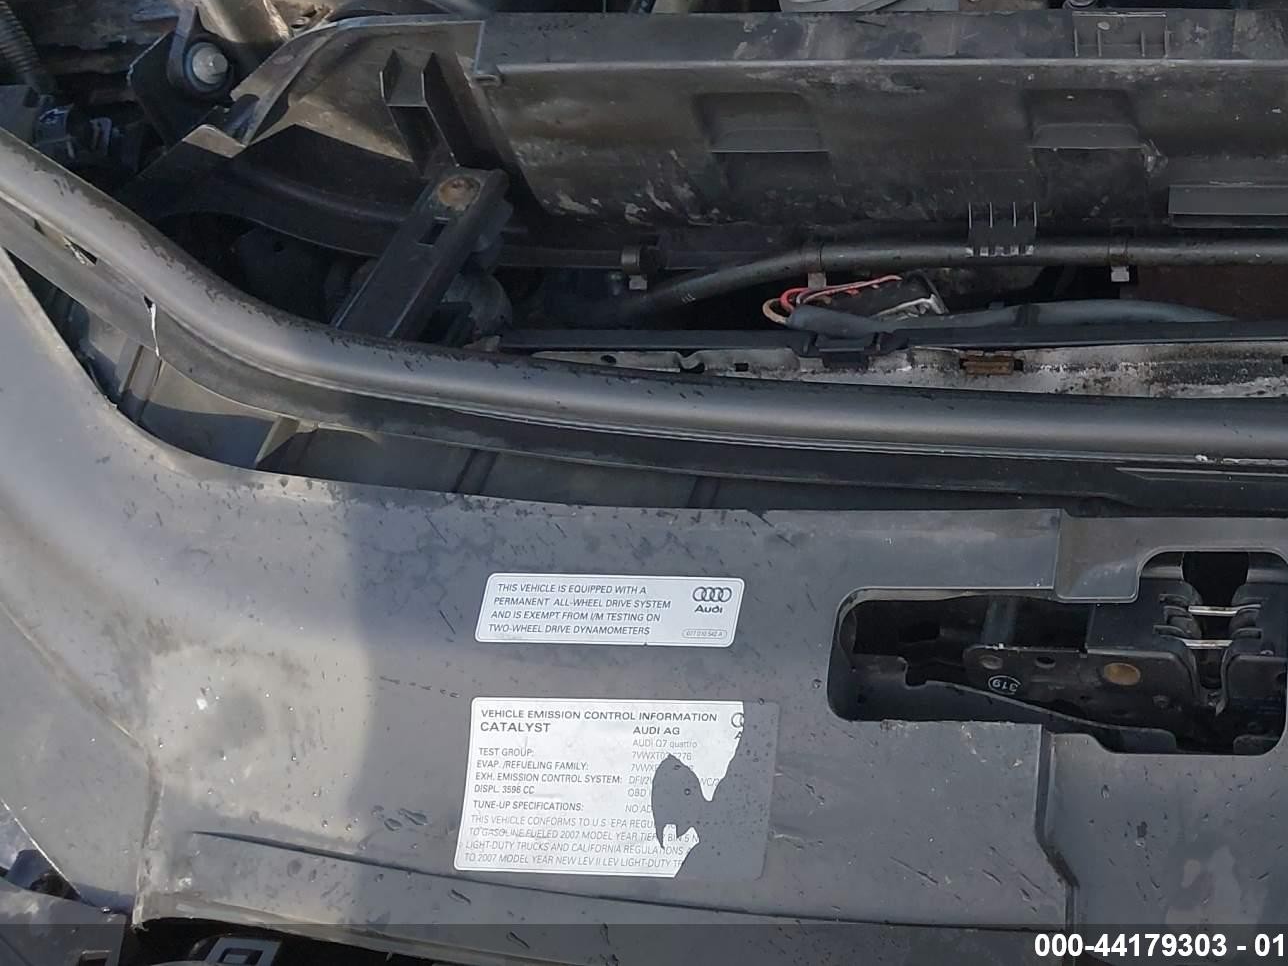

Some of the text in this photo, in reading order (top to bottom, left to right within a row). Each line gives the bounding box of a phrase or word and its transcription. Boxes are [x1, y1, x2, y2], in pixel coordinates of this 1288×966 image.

[498, 583, 647, 594] THIS VEHICLE IS EQUIPPED WITH A
[493, 596, 671, 609] PERMANENT ALL-WHEEL DRIVE SYSTEM
[694, 604, 723, 614] Audi
[491, 610, 661, 622] AND IS EXEMPT FROM I/M TESTING ON
[488, 624, 650, 635] TWO-WHEEL DRIVE DYNAMOMETERS
[481, 709, 718, 722] VEHICLE EMISSION CONTROL INFORMATION
[480, 721, 552, 733] CATALYST
[633, 726, 681, 735] AUDI AG
[632, 738, 654, 747] AUDI
[655, 739, 668, 748] Q7
[479, 747, 534, 757] TEST GROUP:
[502, 761, 553, 770] /REFUELING
[554, 762, 589, 771] FAMILY:
[475, 772, 495, 781] EXH.
[497, 772, 539, 782] EMISSION
[541, 773, 582, 783] CONTROL
[584, 774, 622, 784] SYSTEM:
[523, 786, 535, 794] CC
[627, 788, 647, 797] OBD
[473, 800, 584, 812] TUNE-UP SPECIFICATIONS:
[625, 804, 639, 813] NO
[471, 814, 577, 826] THIS VEHICLE CONFORMS
[560, 830, 580, 840] 2007
[582, 830, 613, 841] MODEL
[465, 840, 621, 854] LIGHT-DUTY TRUCKS AND CALIFORNIA
[499, 854, 529, 864] MODEL
[531, 855, 554, 865] YEAR
[555, 856, 576, 866] NEW
[577, 856, 595, 866] LEV
[602, 857, 619, 867] LEV
[620, 858, 671, 868] LIGHT-DUTY
